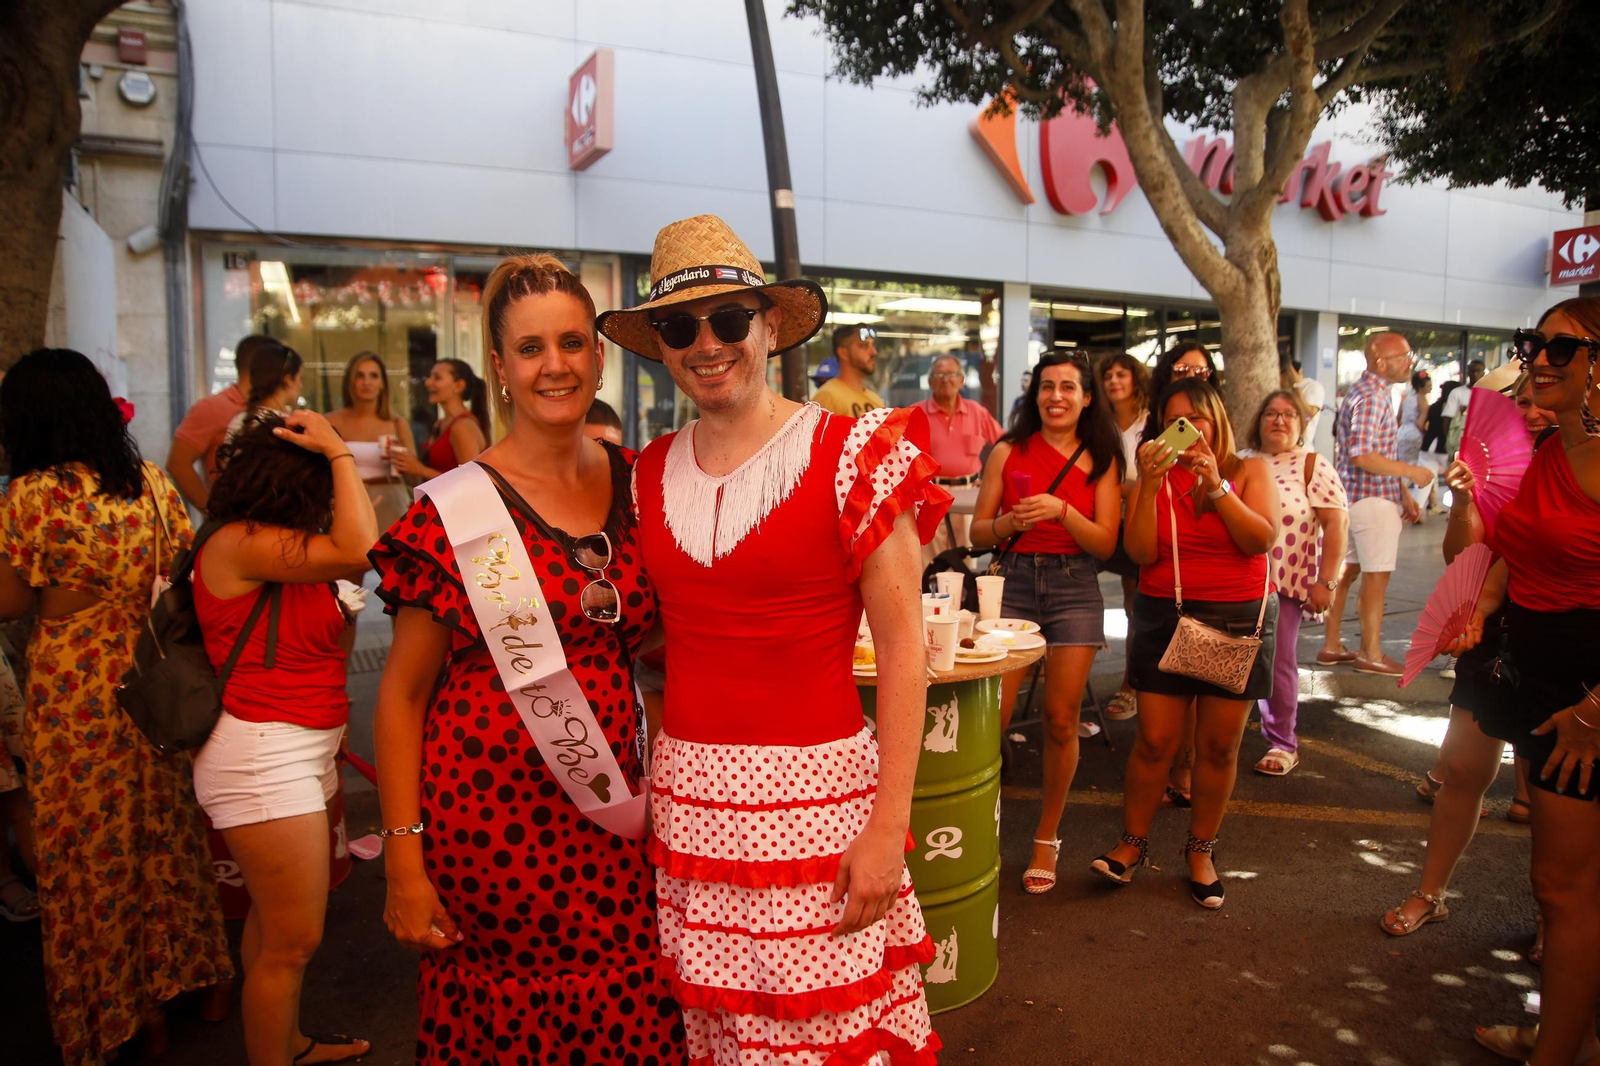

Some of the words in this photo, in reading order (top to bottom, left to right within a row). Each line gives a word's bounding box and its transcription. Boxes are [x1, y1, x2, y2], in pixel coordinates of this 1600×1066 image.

[1184, 134, 1394, 221] mrket
[663, 267, 710, 292] Legendario
[1558, 263, 1596, 279] market
[550, 716, 599, 787] Be
